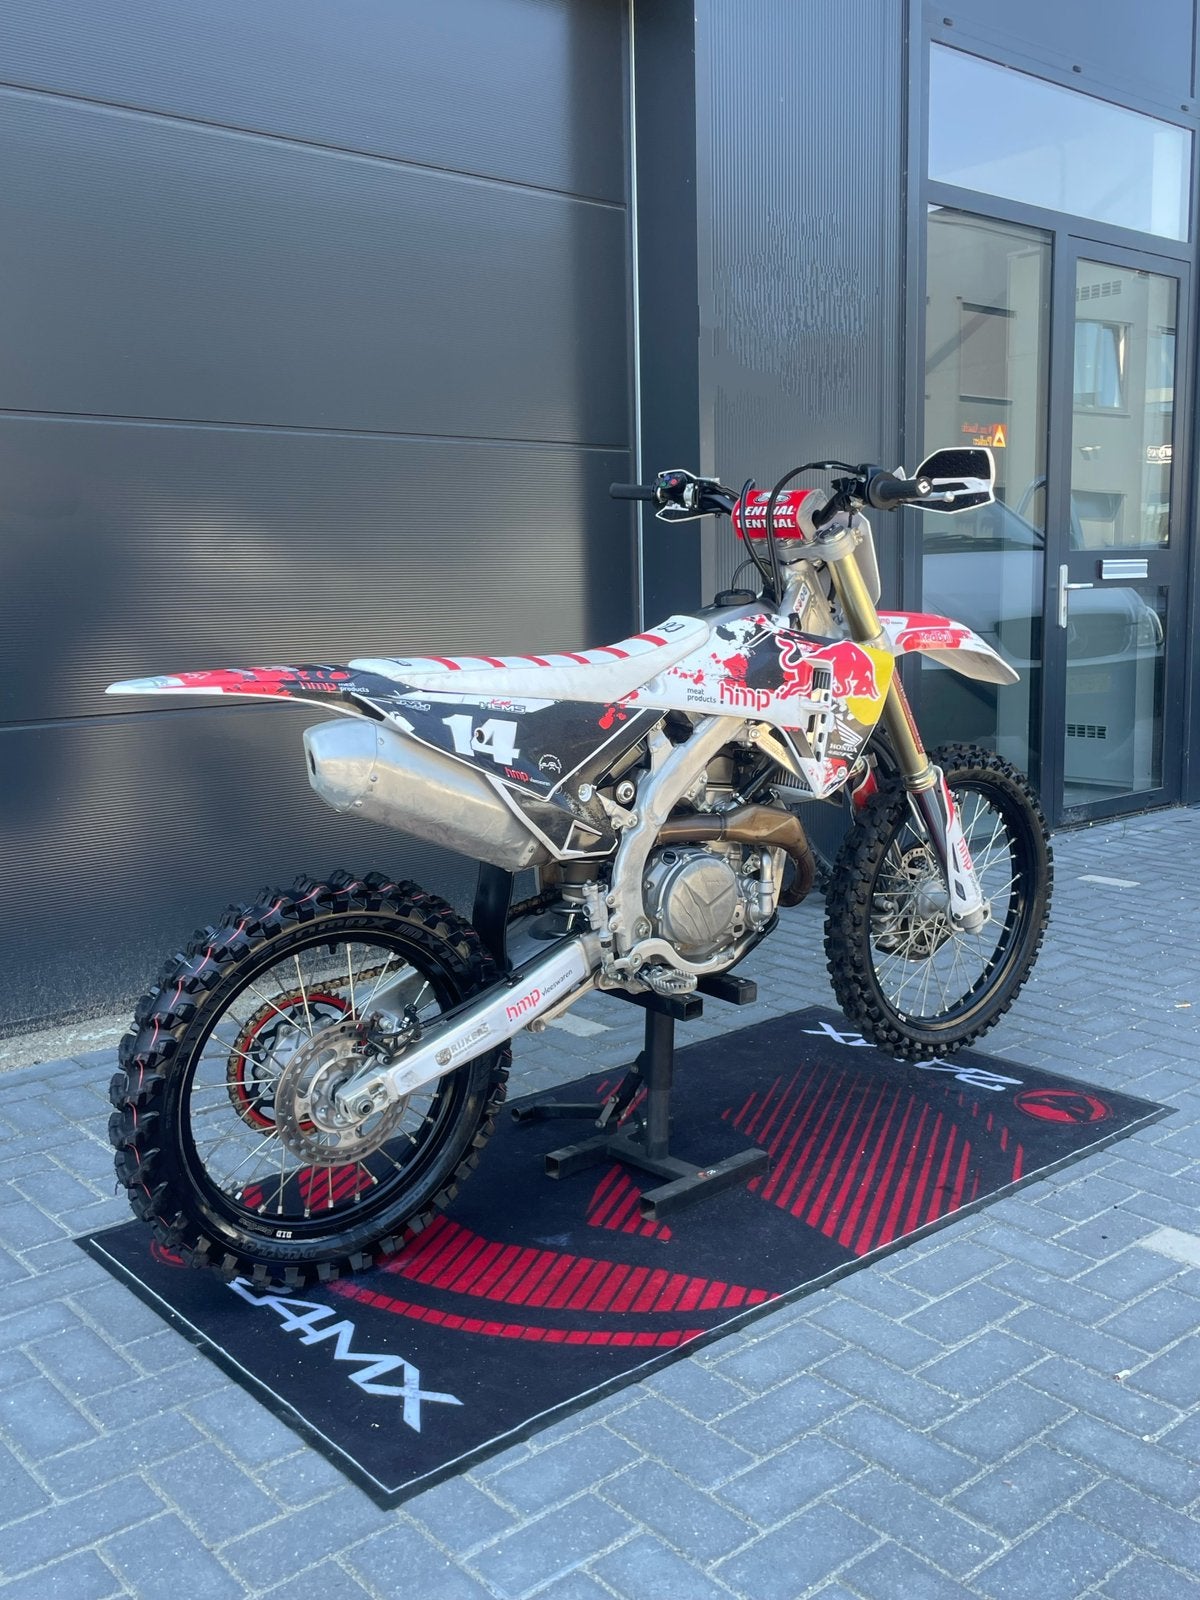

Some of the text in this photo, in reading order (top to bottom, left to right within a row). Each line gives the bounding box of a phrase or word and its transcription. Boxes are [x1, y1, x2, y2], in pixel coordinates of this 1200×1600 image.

[735, 505, 795, 516] ENTAL
[737, 518, 796, 528] ENTAL
[687, 687, 705, 695] meat
[687, 695, 717, 704] products
[442, 713, 521, 766] 14
[829, 743, 858, 753] HONDA
[541, 969, 574, 996] vleeswaren
[800, 1021, 1024, 1092] 24X
[276, 1229, 293, 1239] DID
